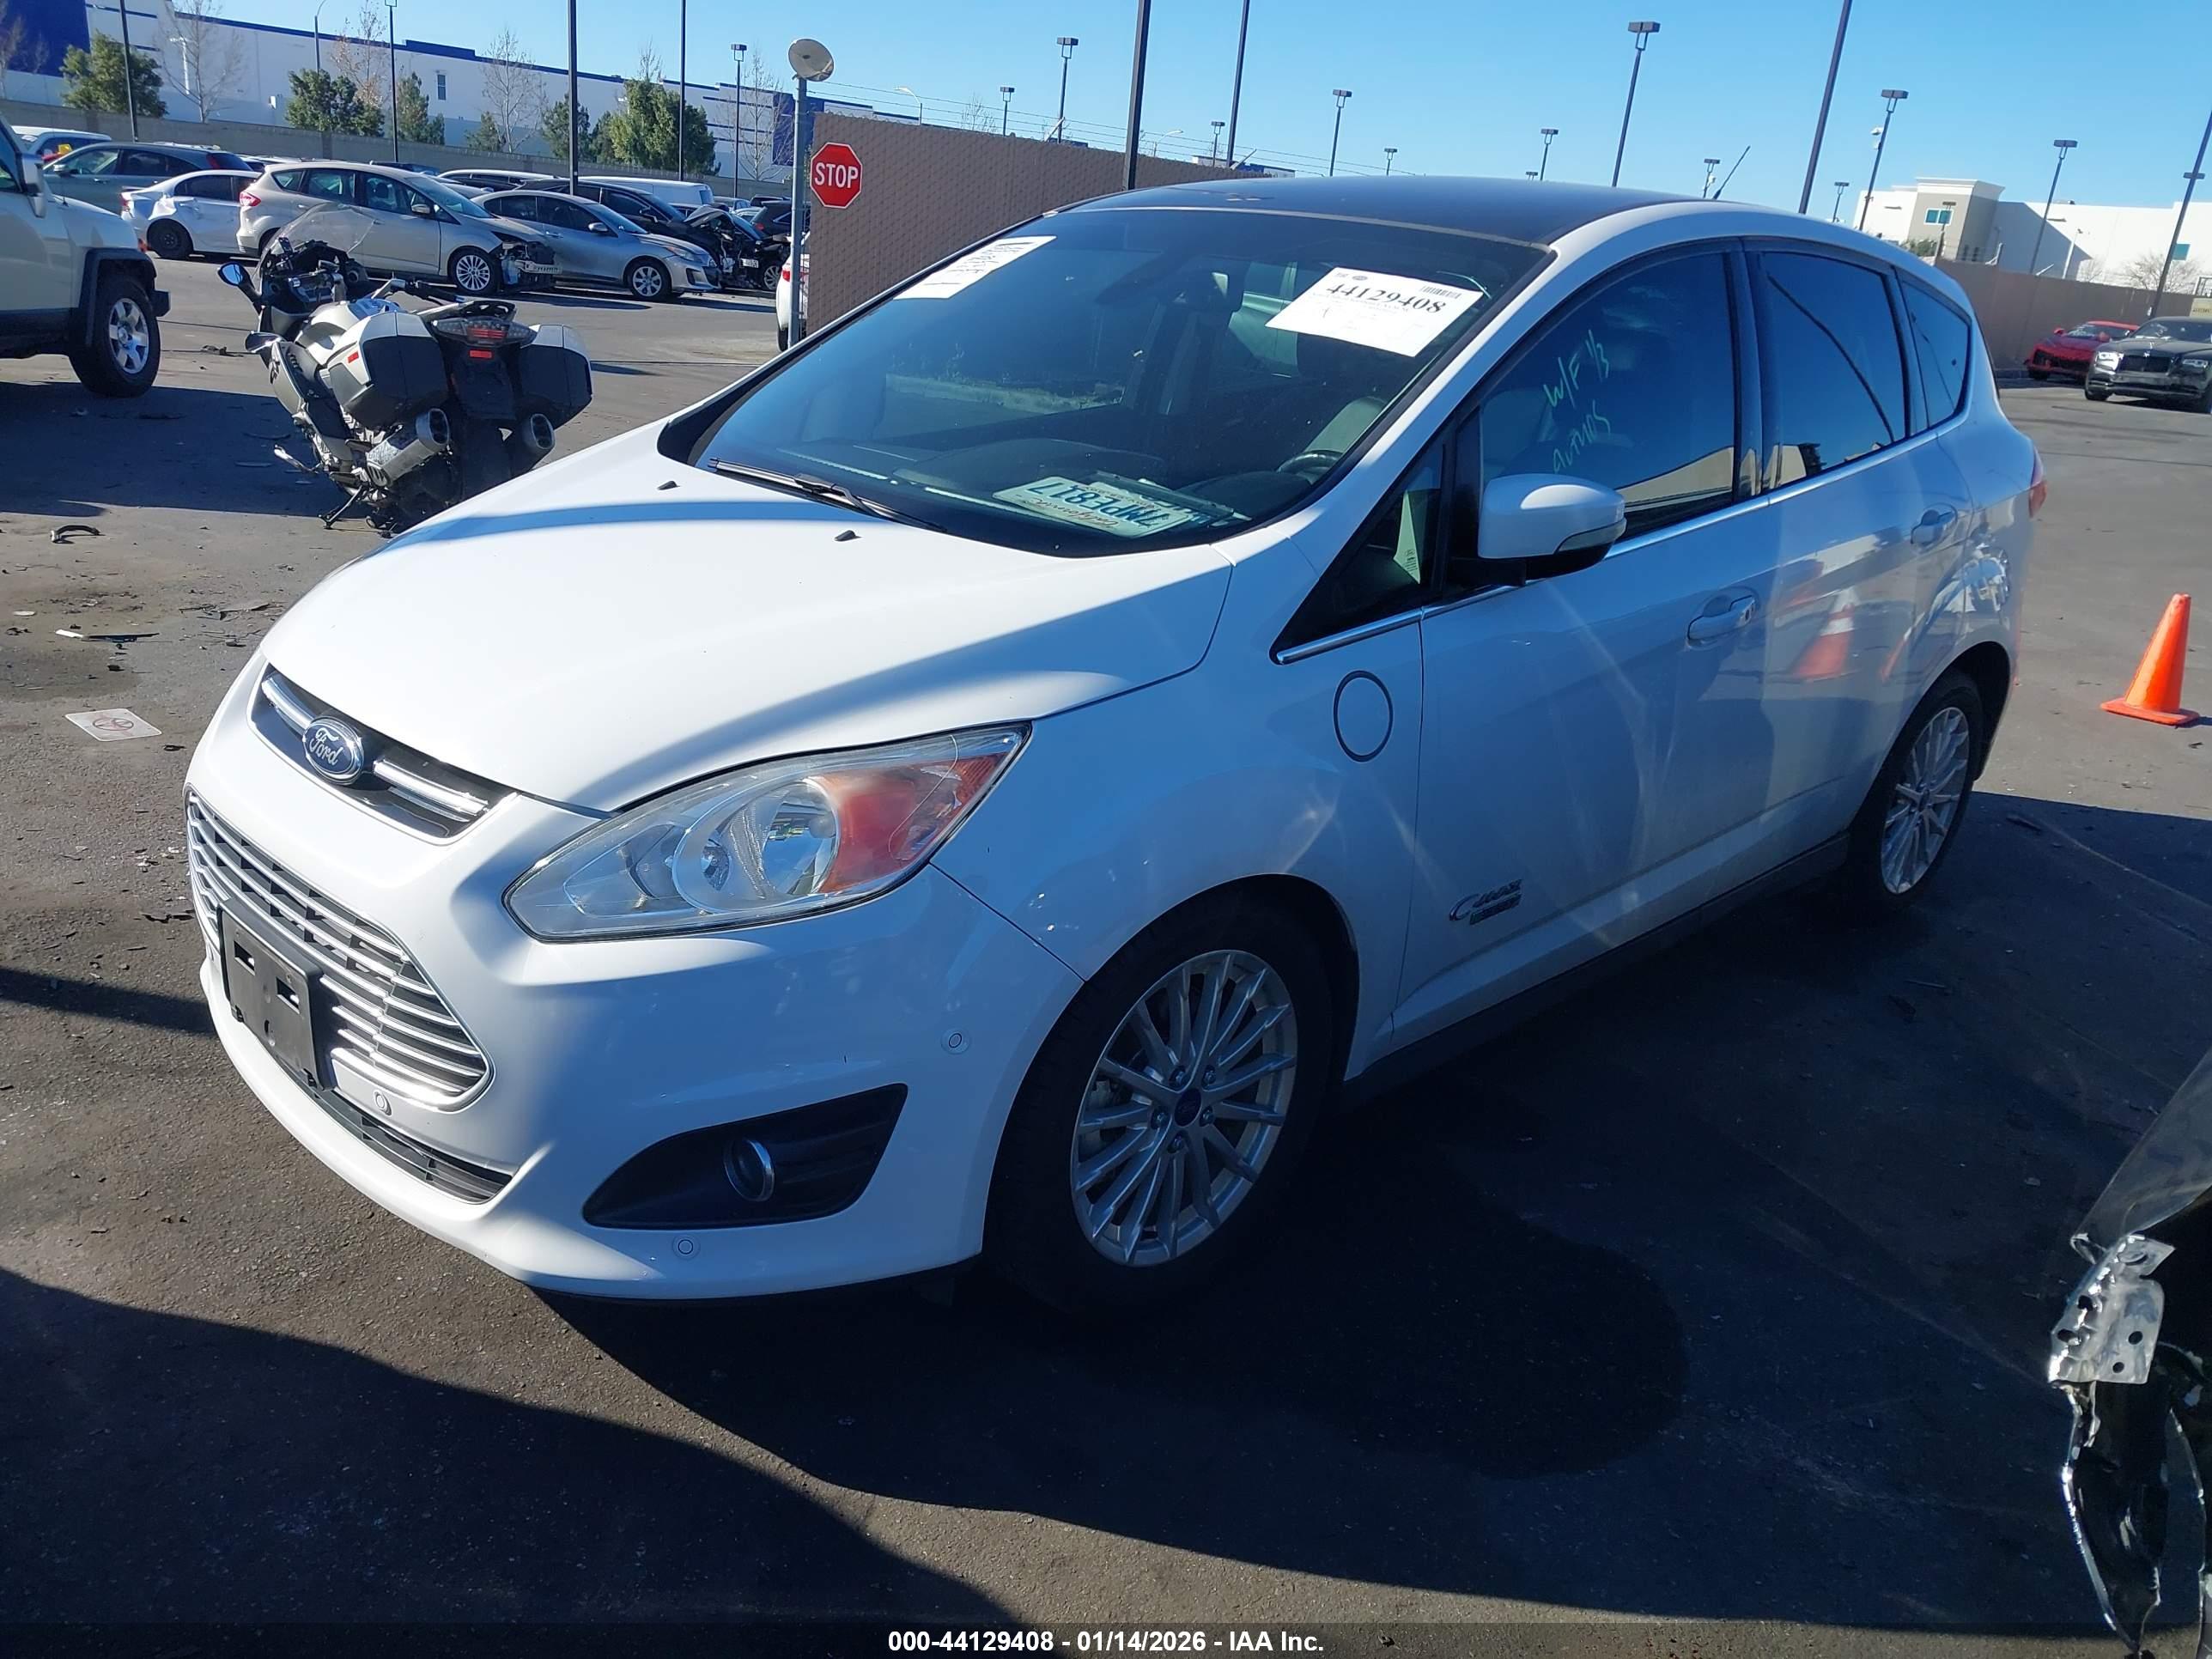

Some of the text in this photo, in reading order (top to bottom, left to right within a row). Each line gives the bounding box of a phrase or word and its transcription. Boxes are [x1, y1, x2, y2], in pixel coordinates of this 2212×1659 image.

[814, 161, 859, 189] STOP
[1325, 283, 1447, 314] 44129408
[1027, 482, 1171, 527] 7MPE817
[309, 727, 344, 766] Ford
